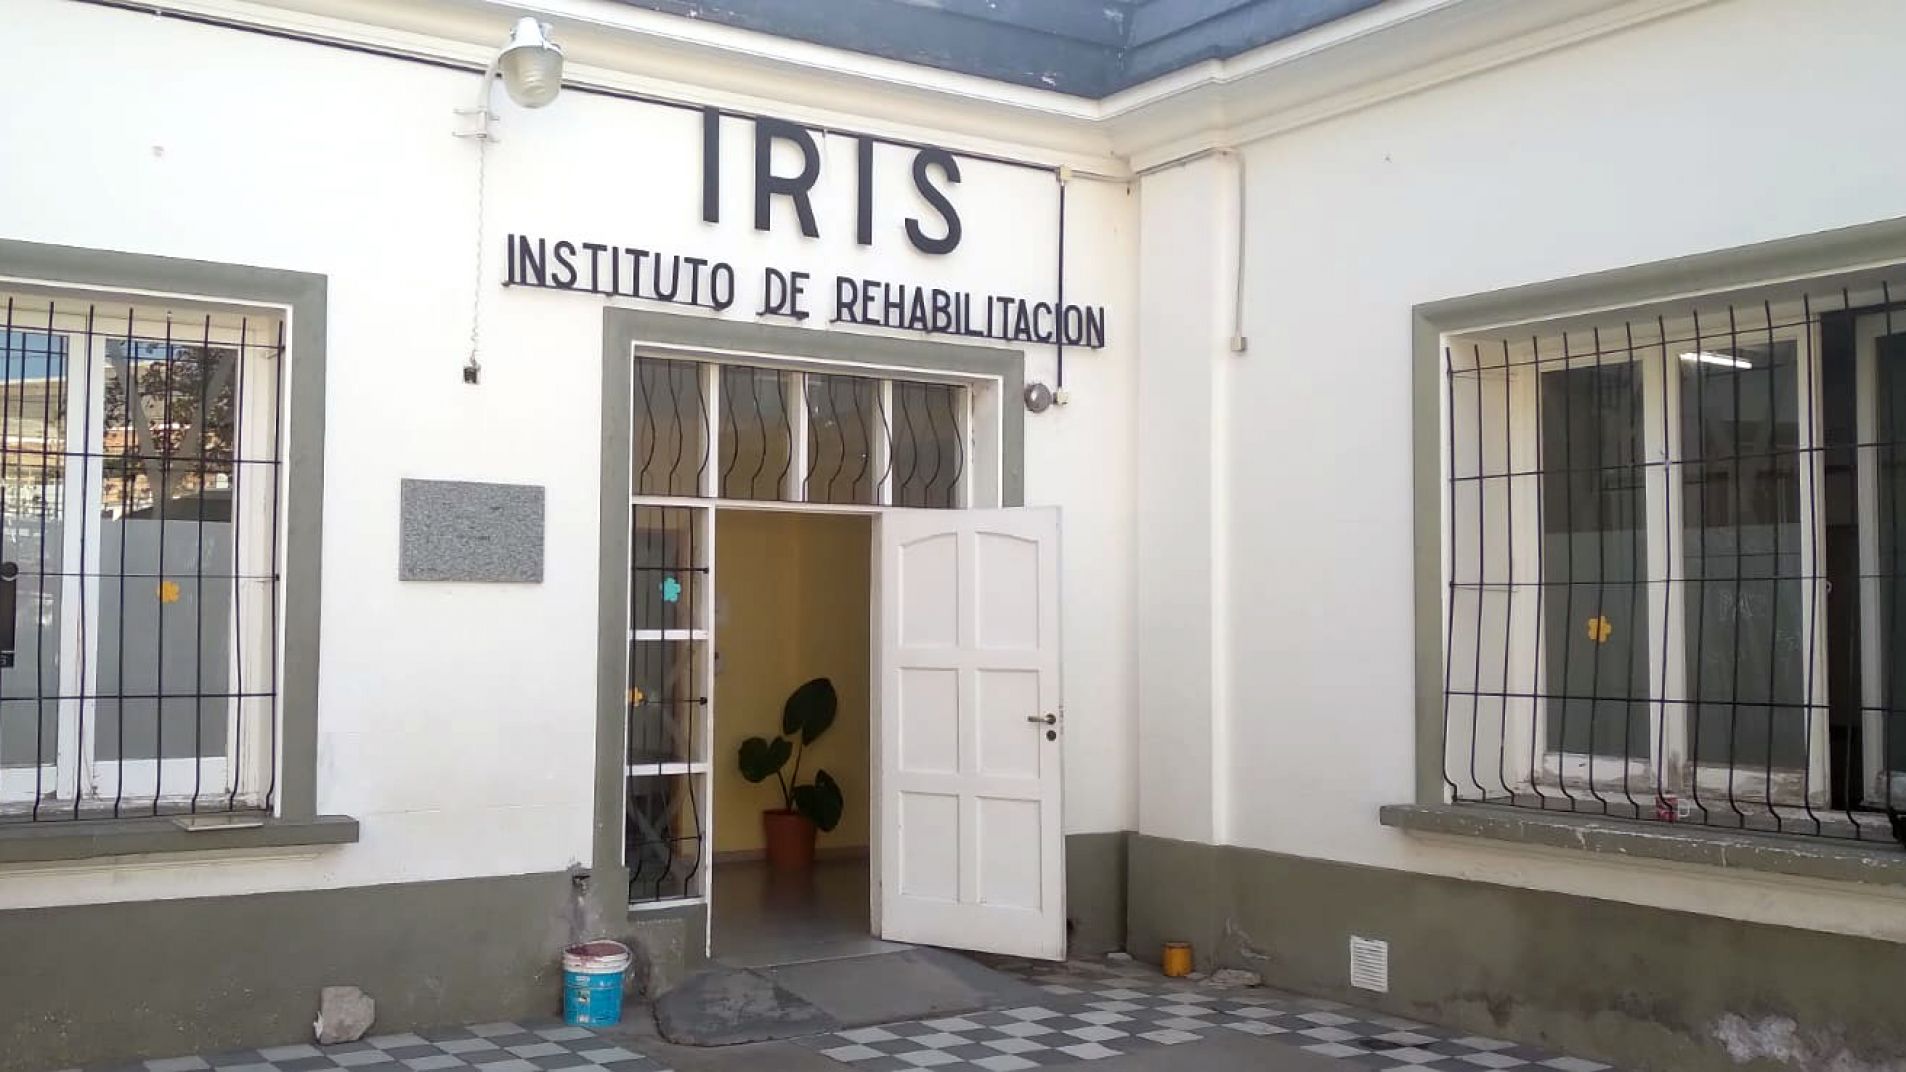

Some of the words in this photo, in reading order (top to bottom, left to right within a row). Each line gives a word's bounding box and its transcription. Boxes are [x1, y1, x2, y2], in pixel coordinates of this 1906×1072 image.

[702, 107, 962, 255] IRIS
[507, 233, 735, 310] INSTITUTO
[763, 267, 810, 319] DE
[835, 276, 1105, 347] REHABILITACION
